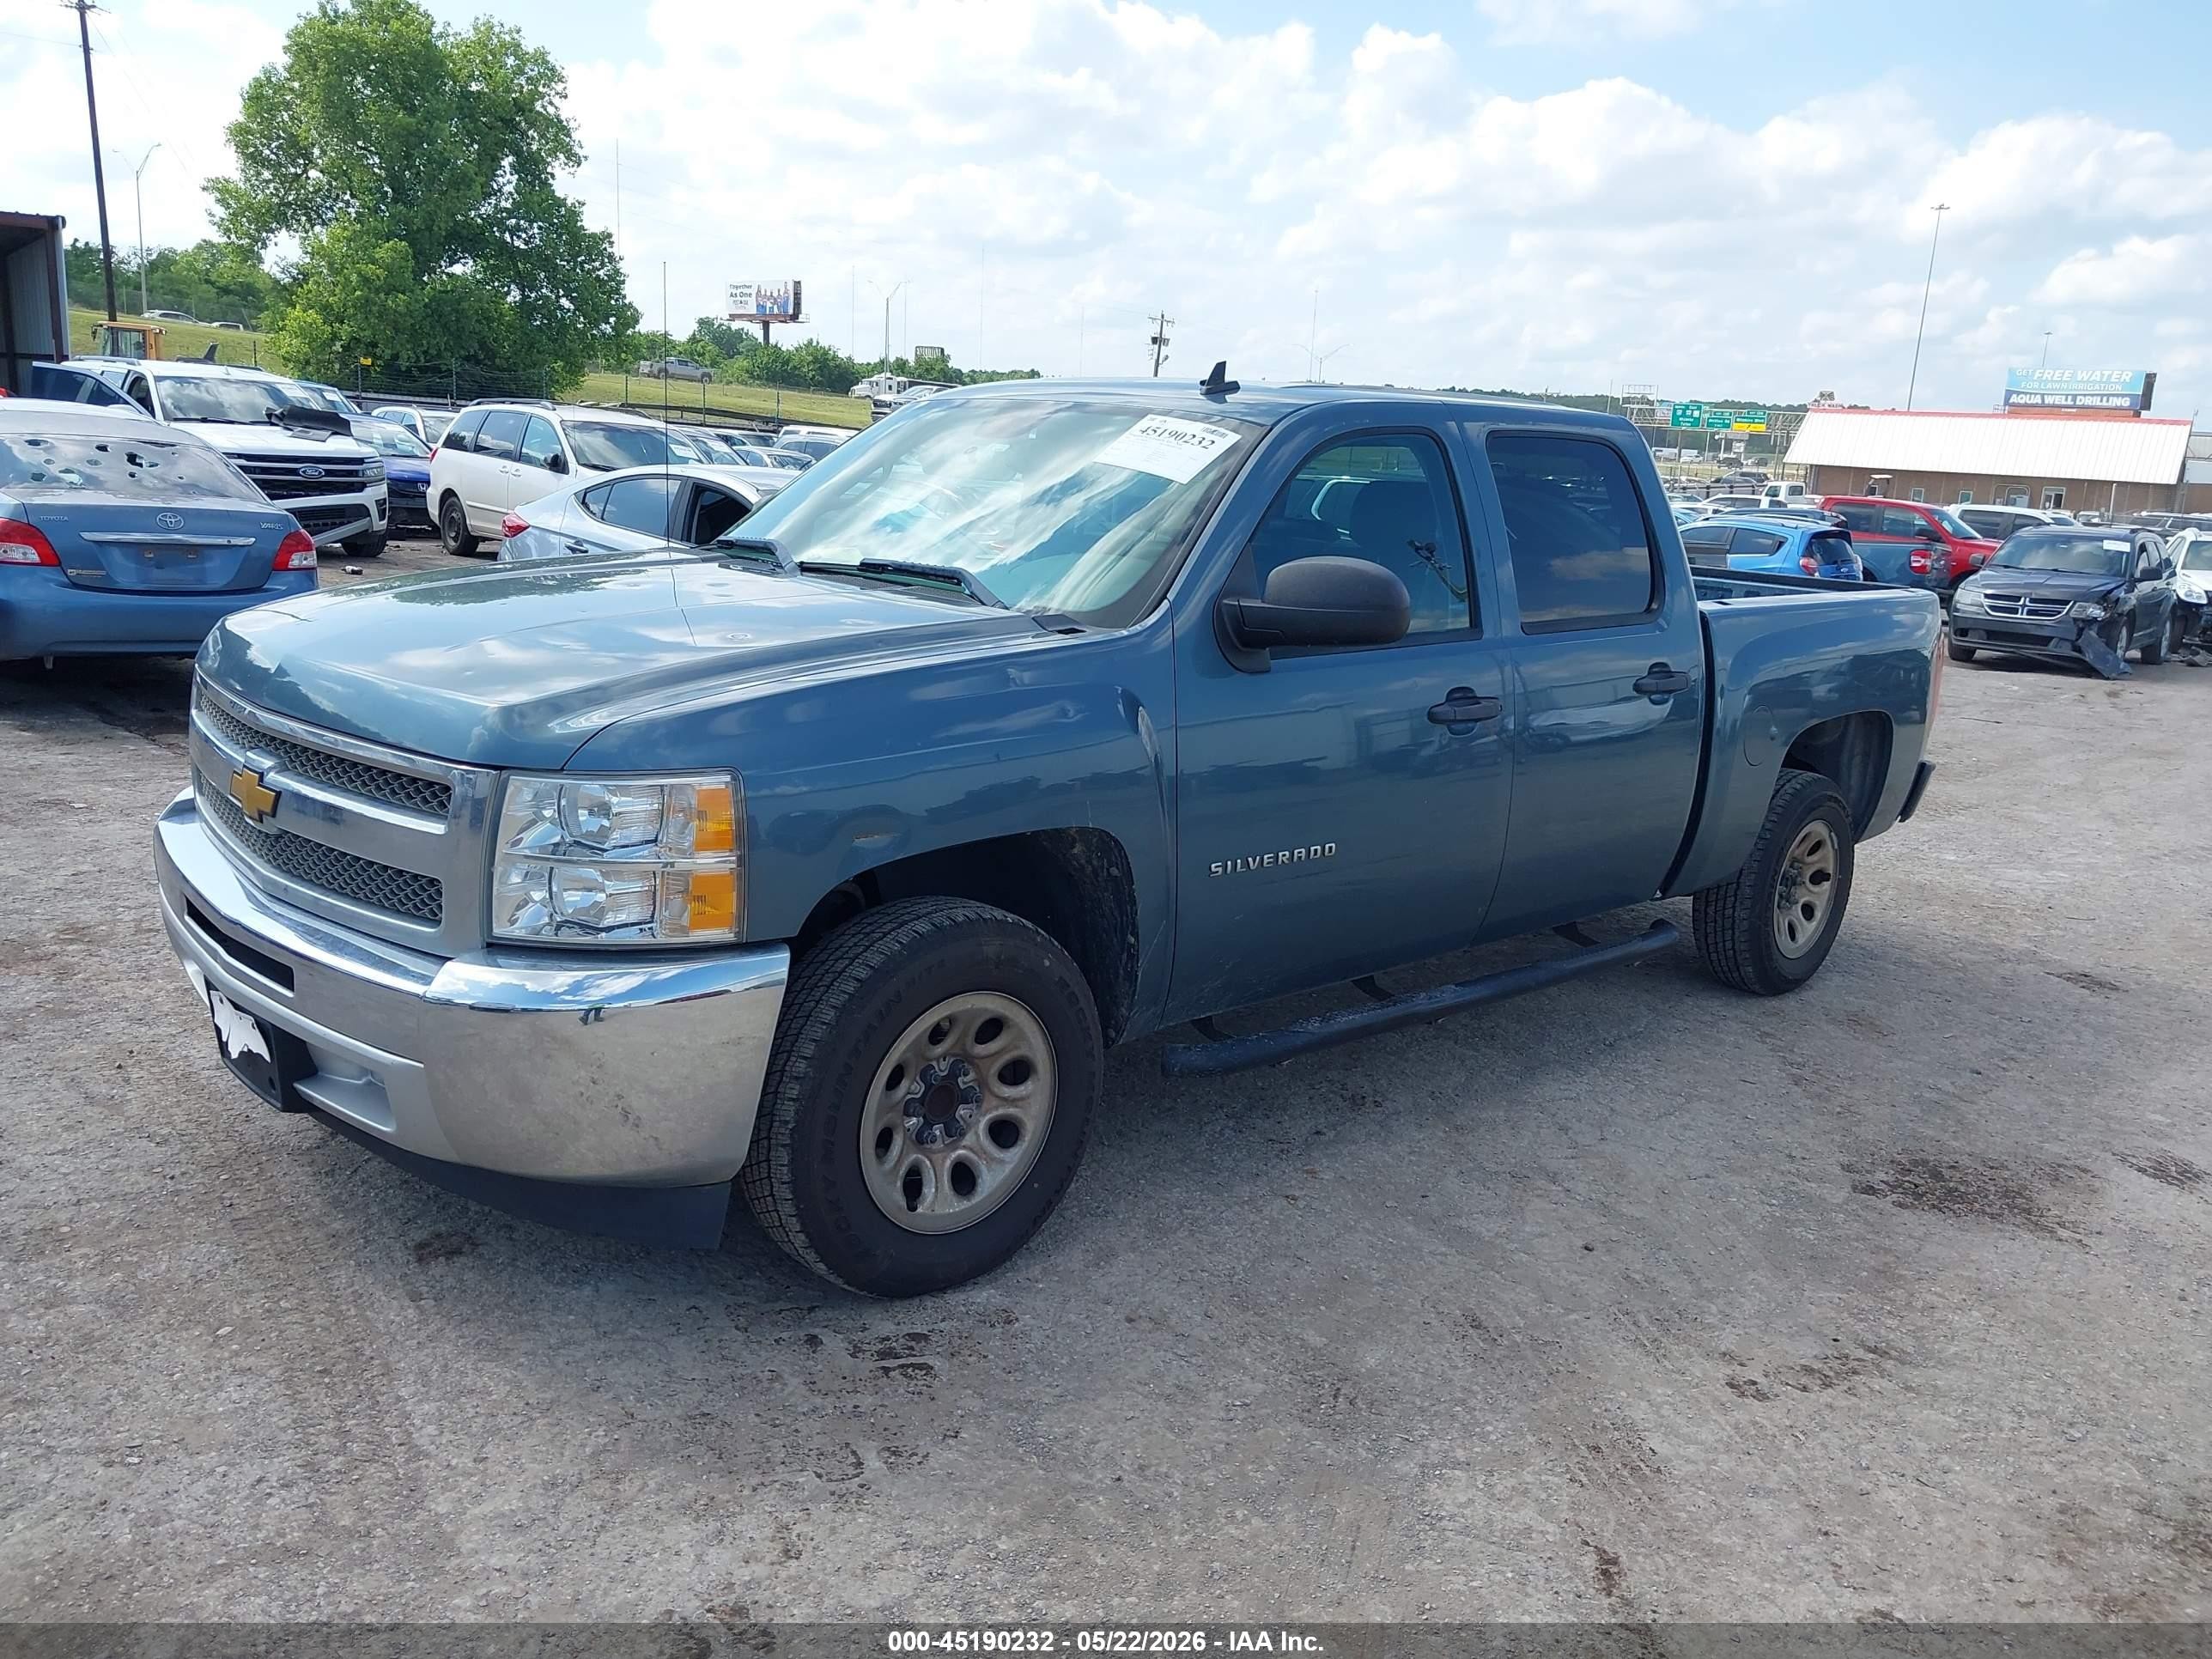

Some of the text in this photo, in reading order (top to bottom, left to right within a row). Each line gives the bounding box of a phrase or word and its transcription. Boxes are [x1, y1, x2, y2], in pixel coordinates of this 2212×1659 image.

[2033, 369, 2075, 381] FREE
[2077, 370, 2132, 382] WATER
[2069, 383, 2123, 392] IRRIGATION
[2009, 393, 2130, 407] AQUA WELL DRILLING
[1139, 426, 1216, 449] 45190232
[260, 521, 283, 530] YARIS
[1210, 842, 1336, 877] SILVERADO
